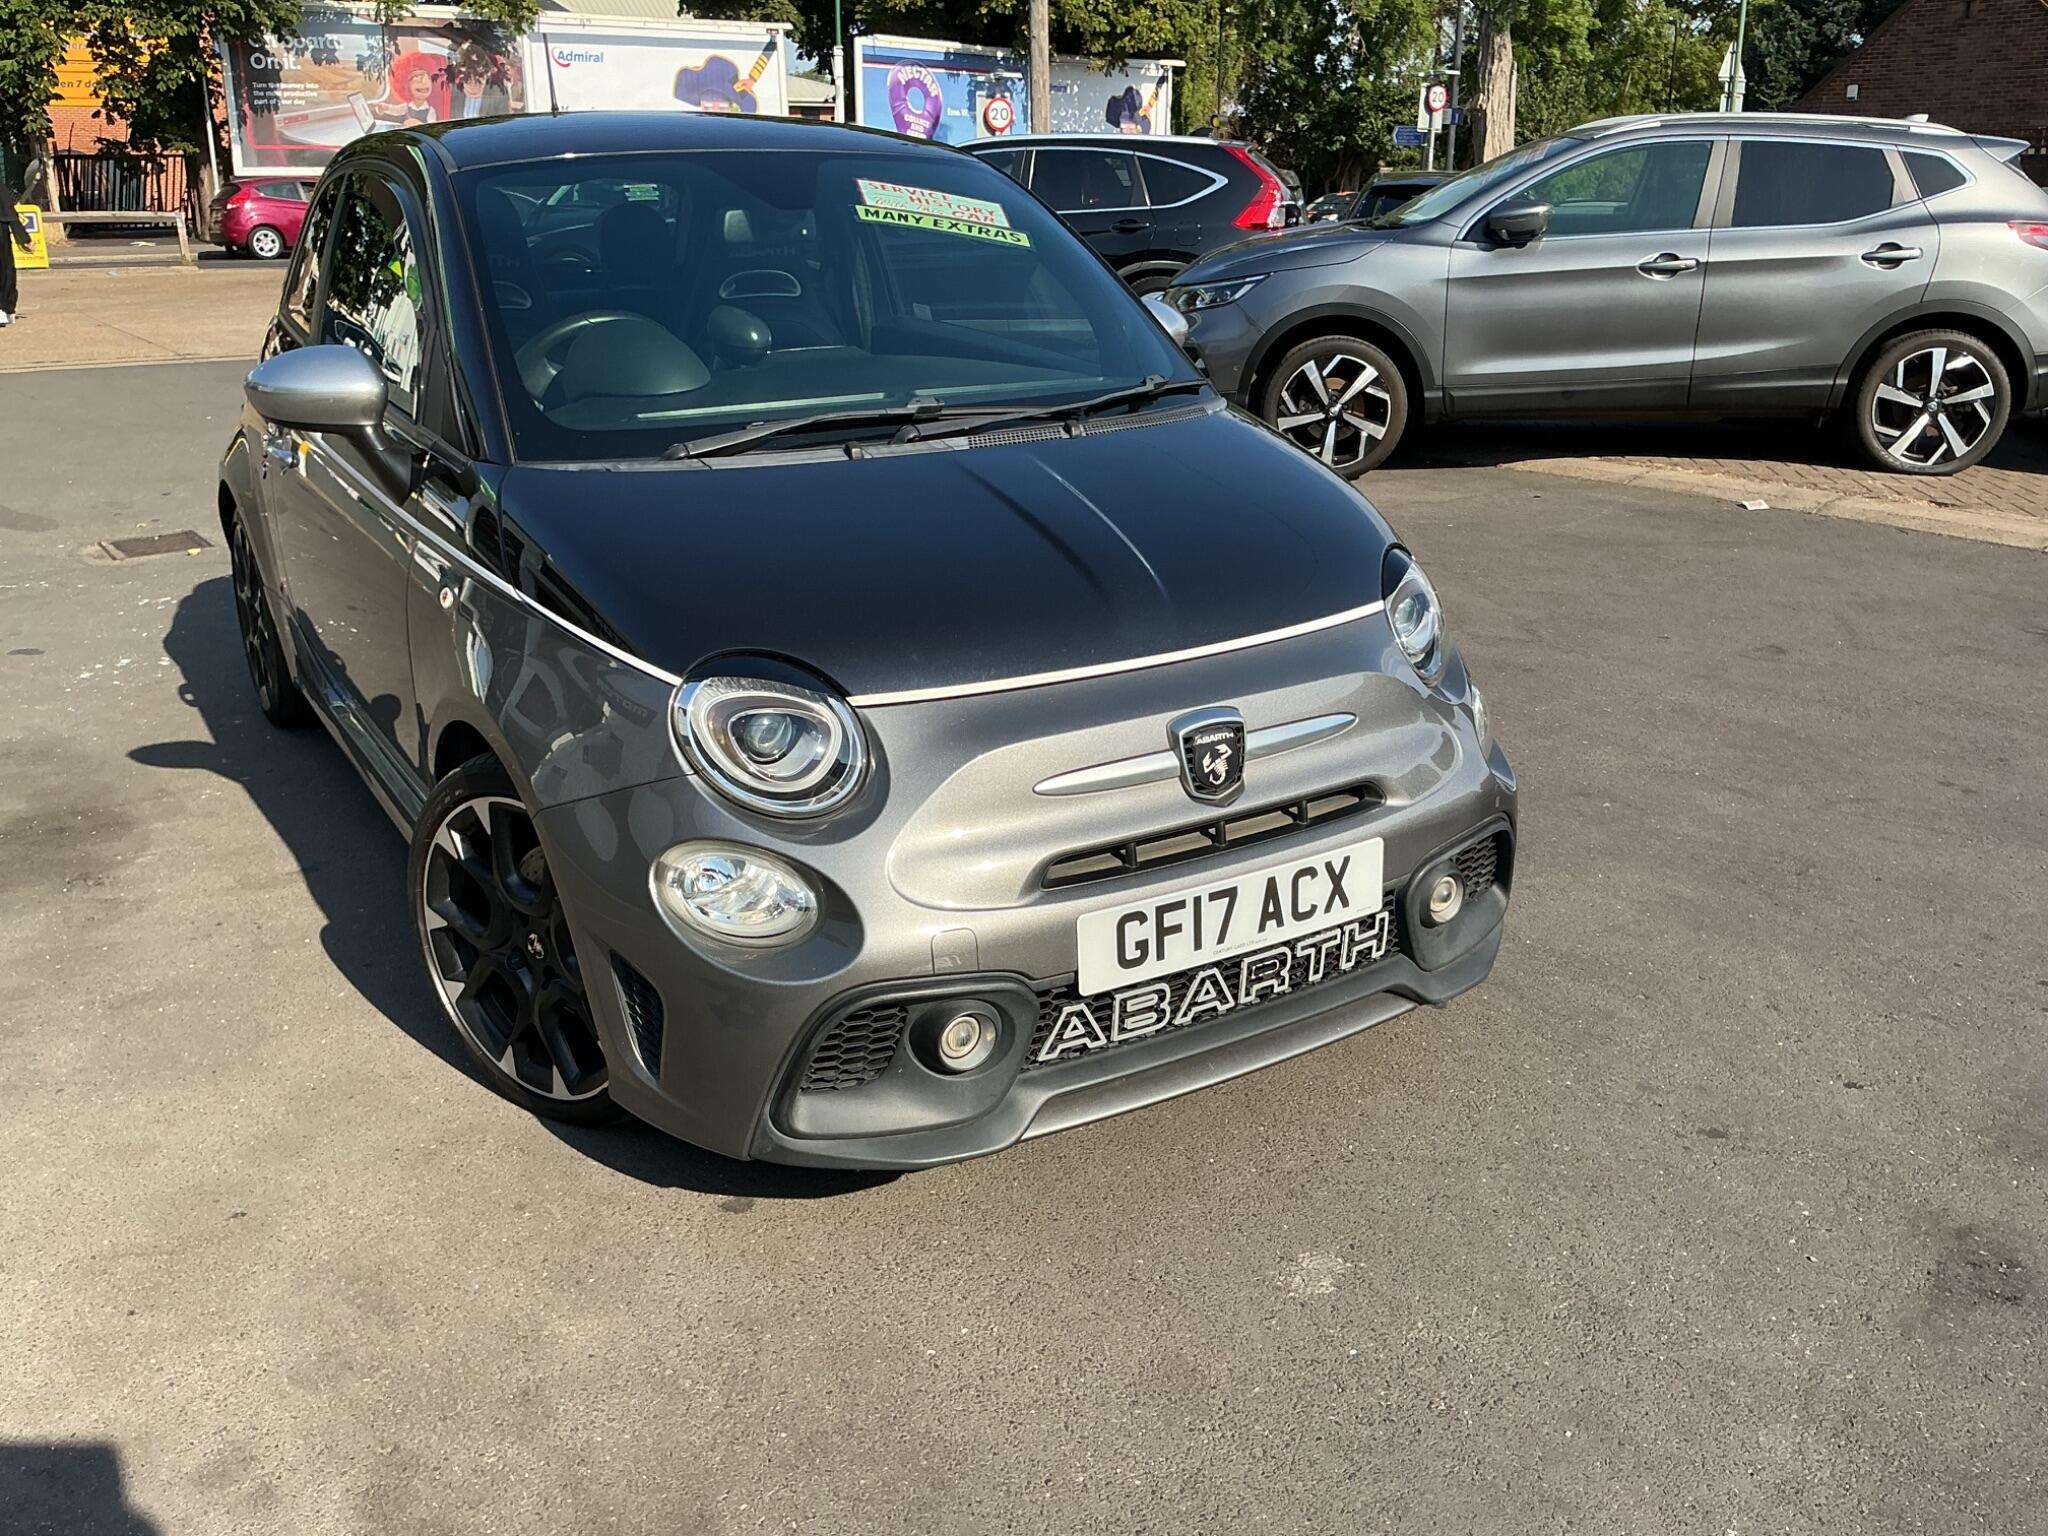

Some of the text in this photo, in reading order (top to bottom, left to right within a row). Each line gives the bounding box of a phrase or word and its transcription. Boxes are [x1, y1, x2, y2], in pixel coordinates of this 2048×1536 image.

[557, 50, 604, 63] Admiral
[897, 65, 938, 97] NECTAR
[1432, 91, 1444, 102] 20
[990, 107, 1009, 121] 20
[868, 181, 952, 201] SERVICE
[908, 195, 996, 216] HISTORY
[864, 208, 1023, 243] MANY EXTRAS
[951, 210, 996, 224] CAR
[1194, 732, 1234, 746] ABARTH
[1115, 854, 1352, 971] GF17 ACX
[1037, 910, 1389, 1062] ABARTH
